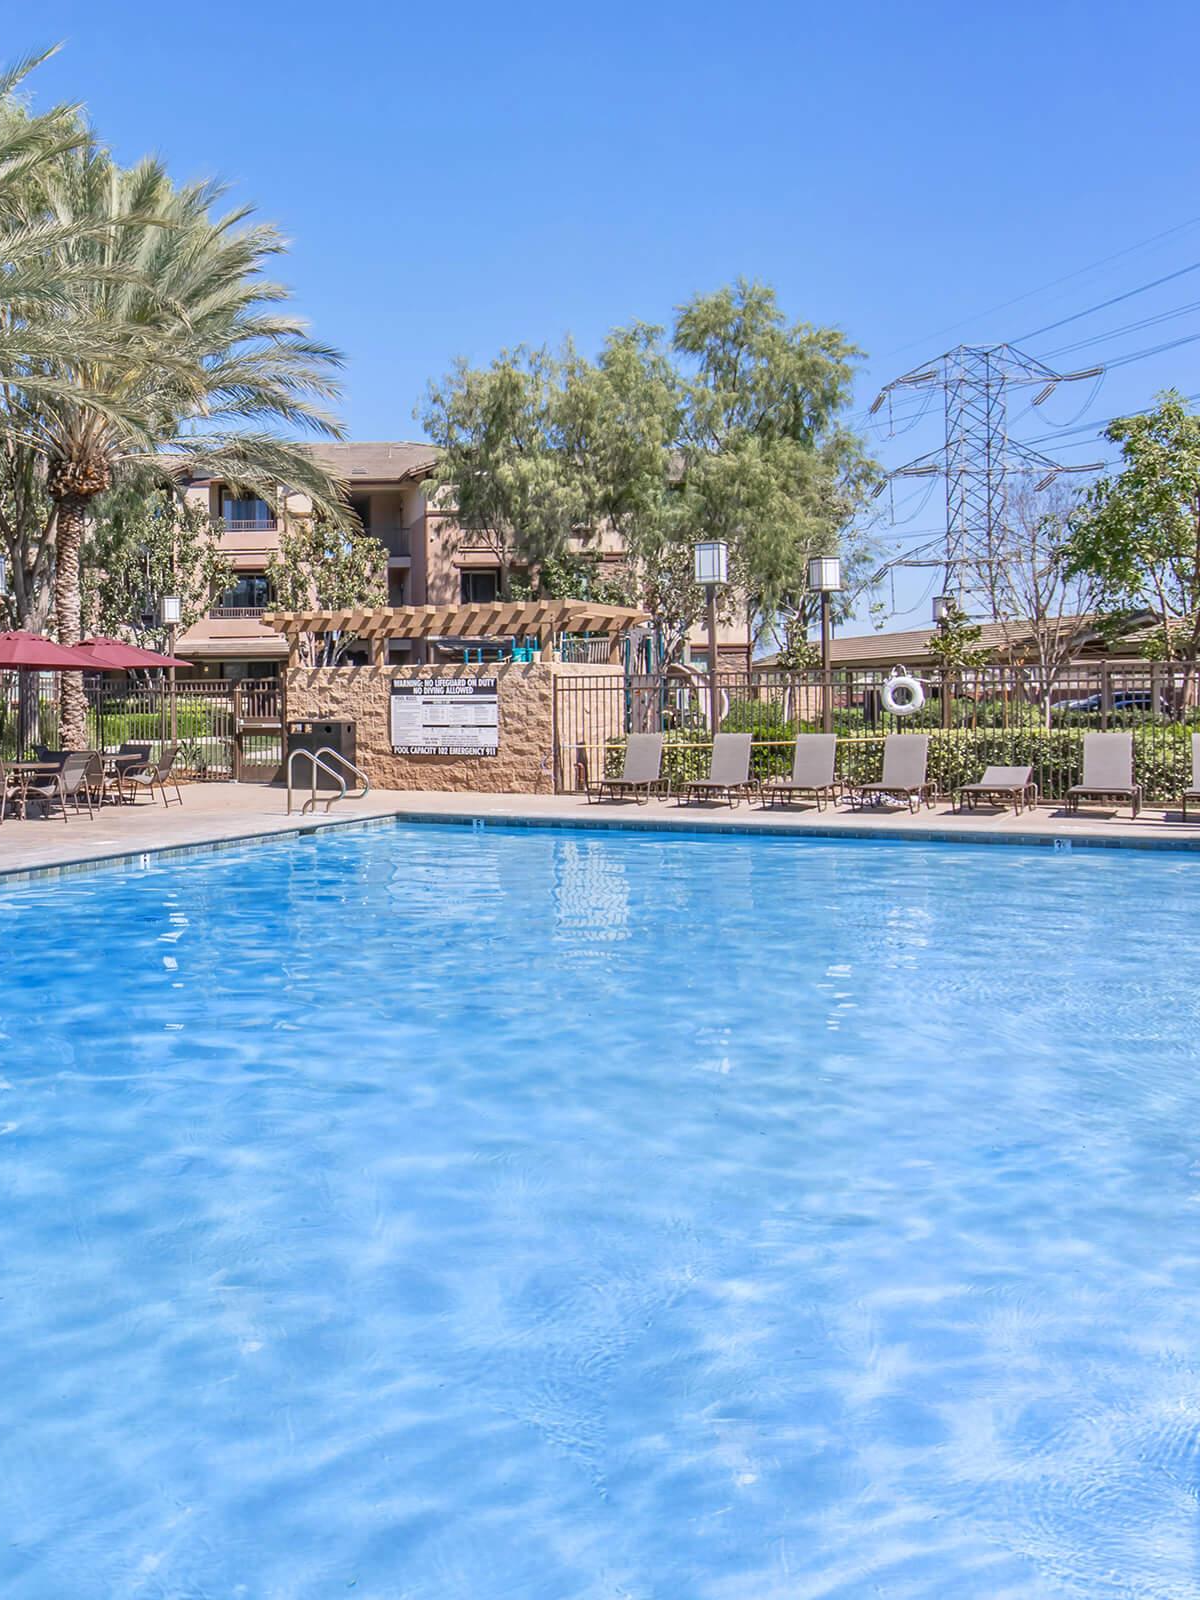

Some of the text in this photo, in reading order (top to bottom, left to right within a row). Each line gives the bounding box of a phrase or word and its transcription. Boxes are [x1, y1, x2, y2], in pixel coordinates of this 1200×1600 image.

[424, 679, 434, 687] NO
[434, 679, 467, 687] LIFEGUARD
[467, 679, 477, 687] ON
[478, 679, 495, 687] DUTY
[413, 687, 422, 695] NO
[423, 687, 445, 695] DIVING
[394, 746, 496, 756] POOL CAPACITY 102 EMERGENCY 911
